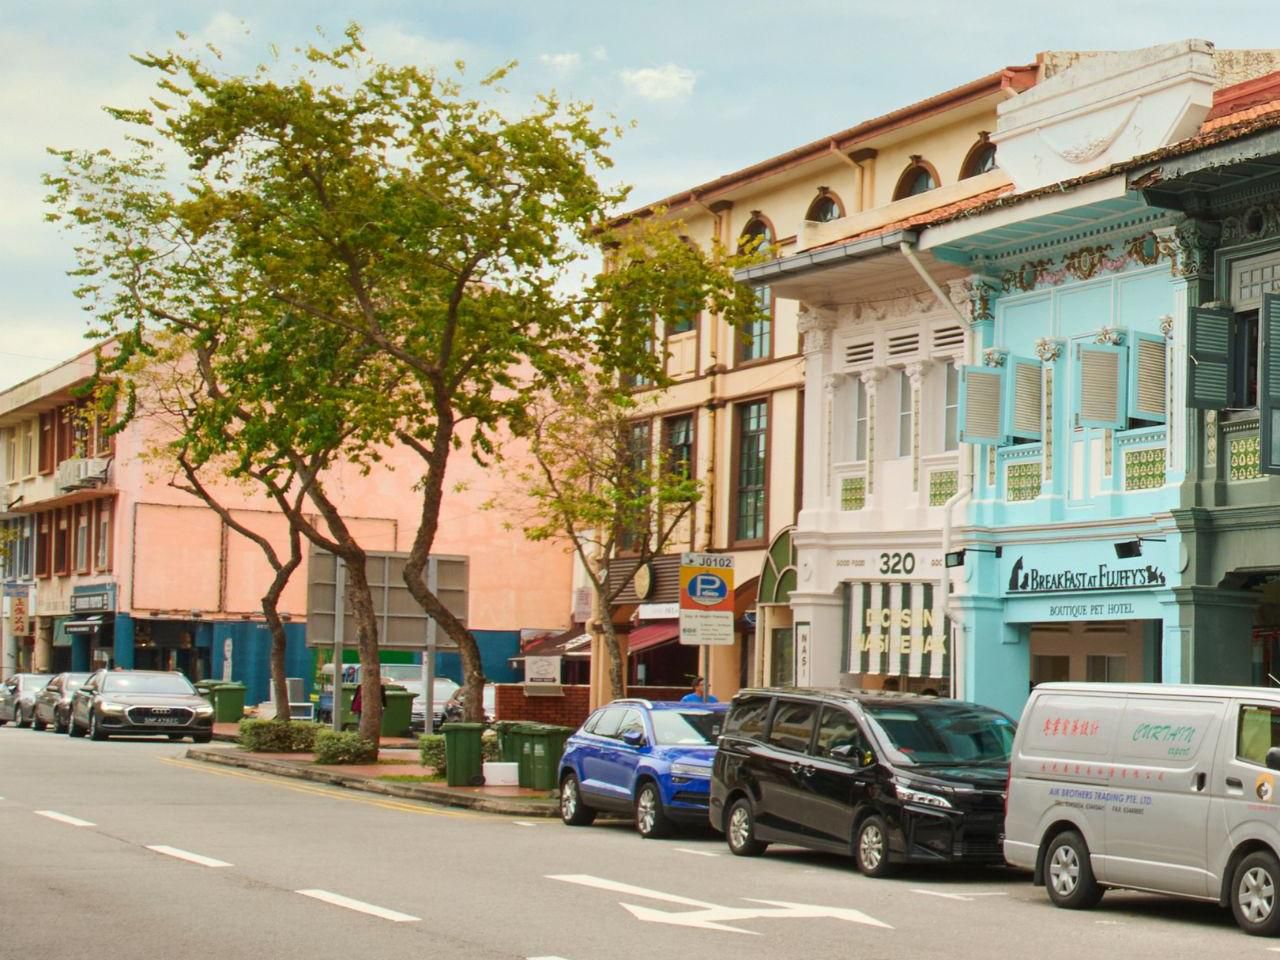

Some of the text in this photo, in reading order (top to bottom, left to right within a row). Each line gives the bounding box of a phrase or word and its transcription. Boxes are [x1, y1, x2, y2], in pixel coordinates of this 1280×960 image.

[699, 558, 732, 568] J0102
[879, 552, 916, 575] 320
[1030, 564, 1146, 590] BREAKFAST AT FLUFFY'S
[1050, 603, 1135, 618] BOUTIQUE PET HOTEL
[1094, 791, 1124, 803] TRADING
